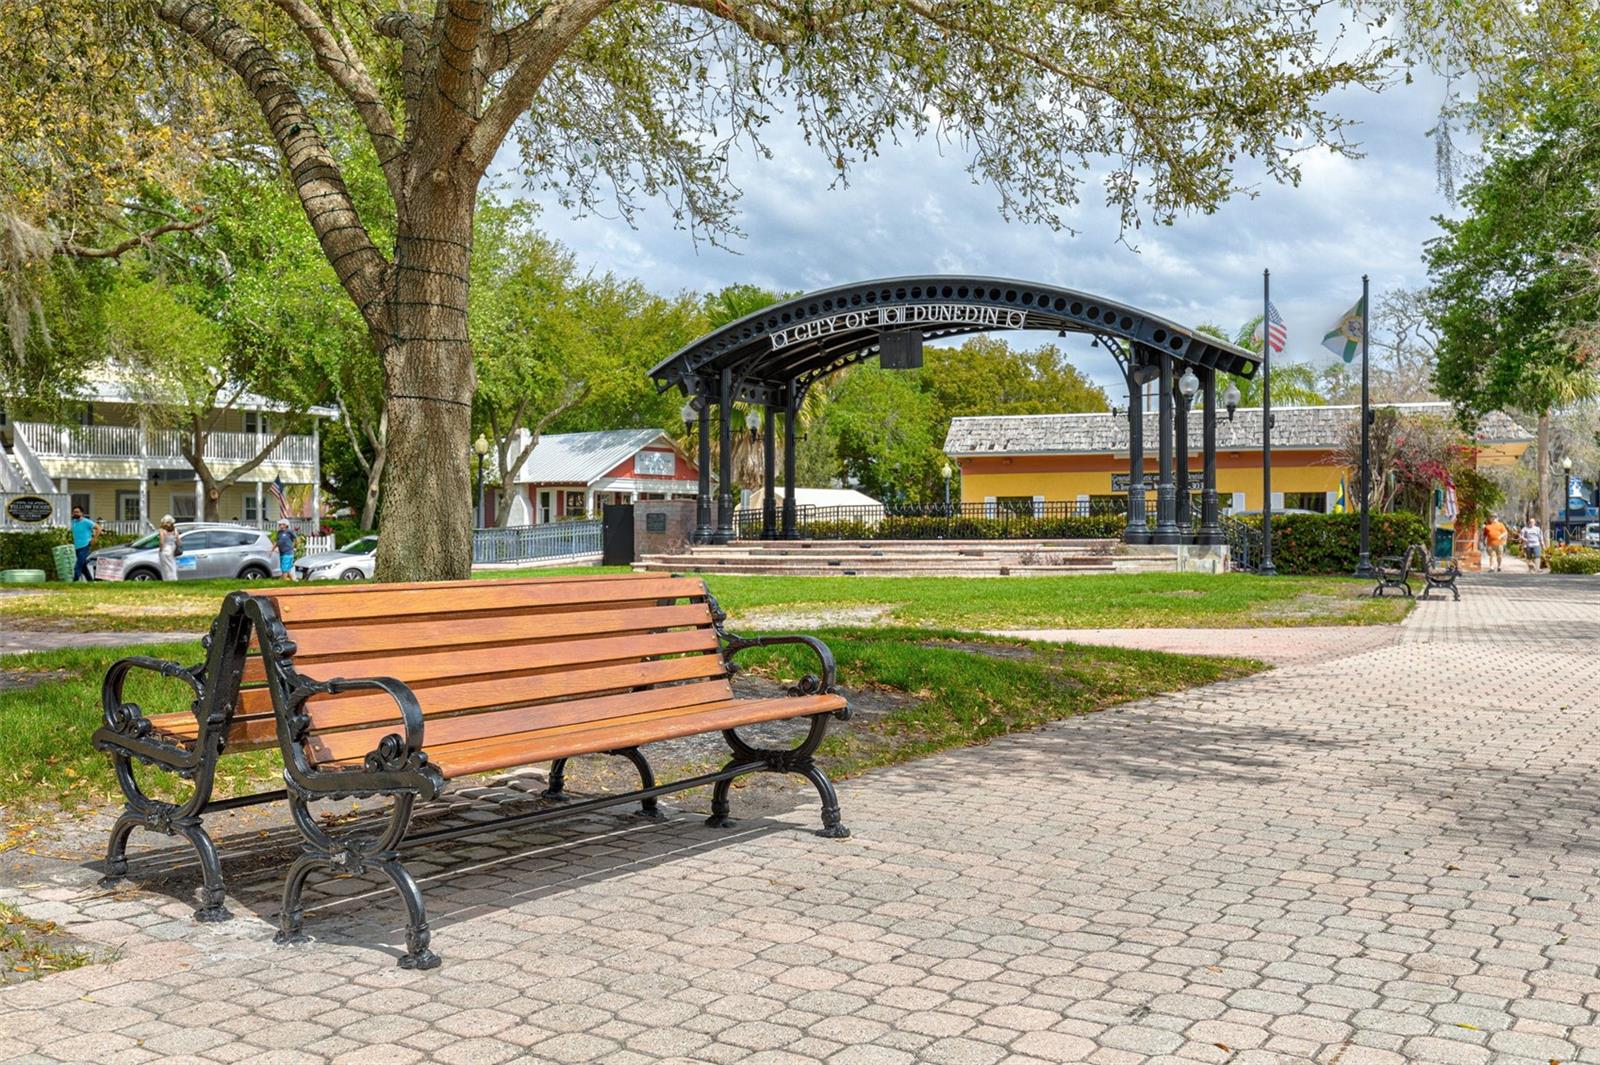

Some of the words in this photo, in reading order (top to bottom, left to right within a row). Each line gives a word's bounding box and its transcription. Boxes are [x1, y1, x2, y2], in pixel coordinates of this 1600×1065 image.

[795, 317, 837, 340] CITY
[846, 311, 871, 328] OF
[913, 305, 1000, 324] DUNEDIN
